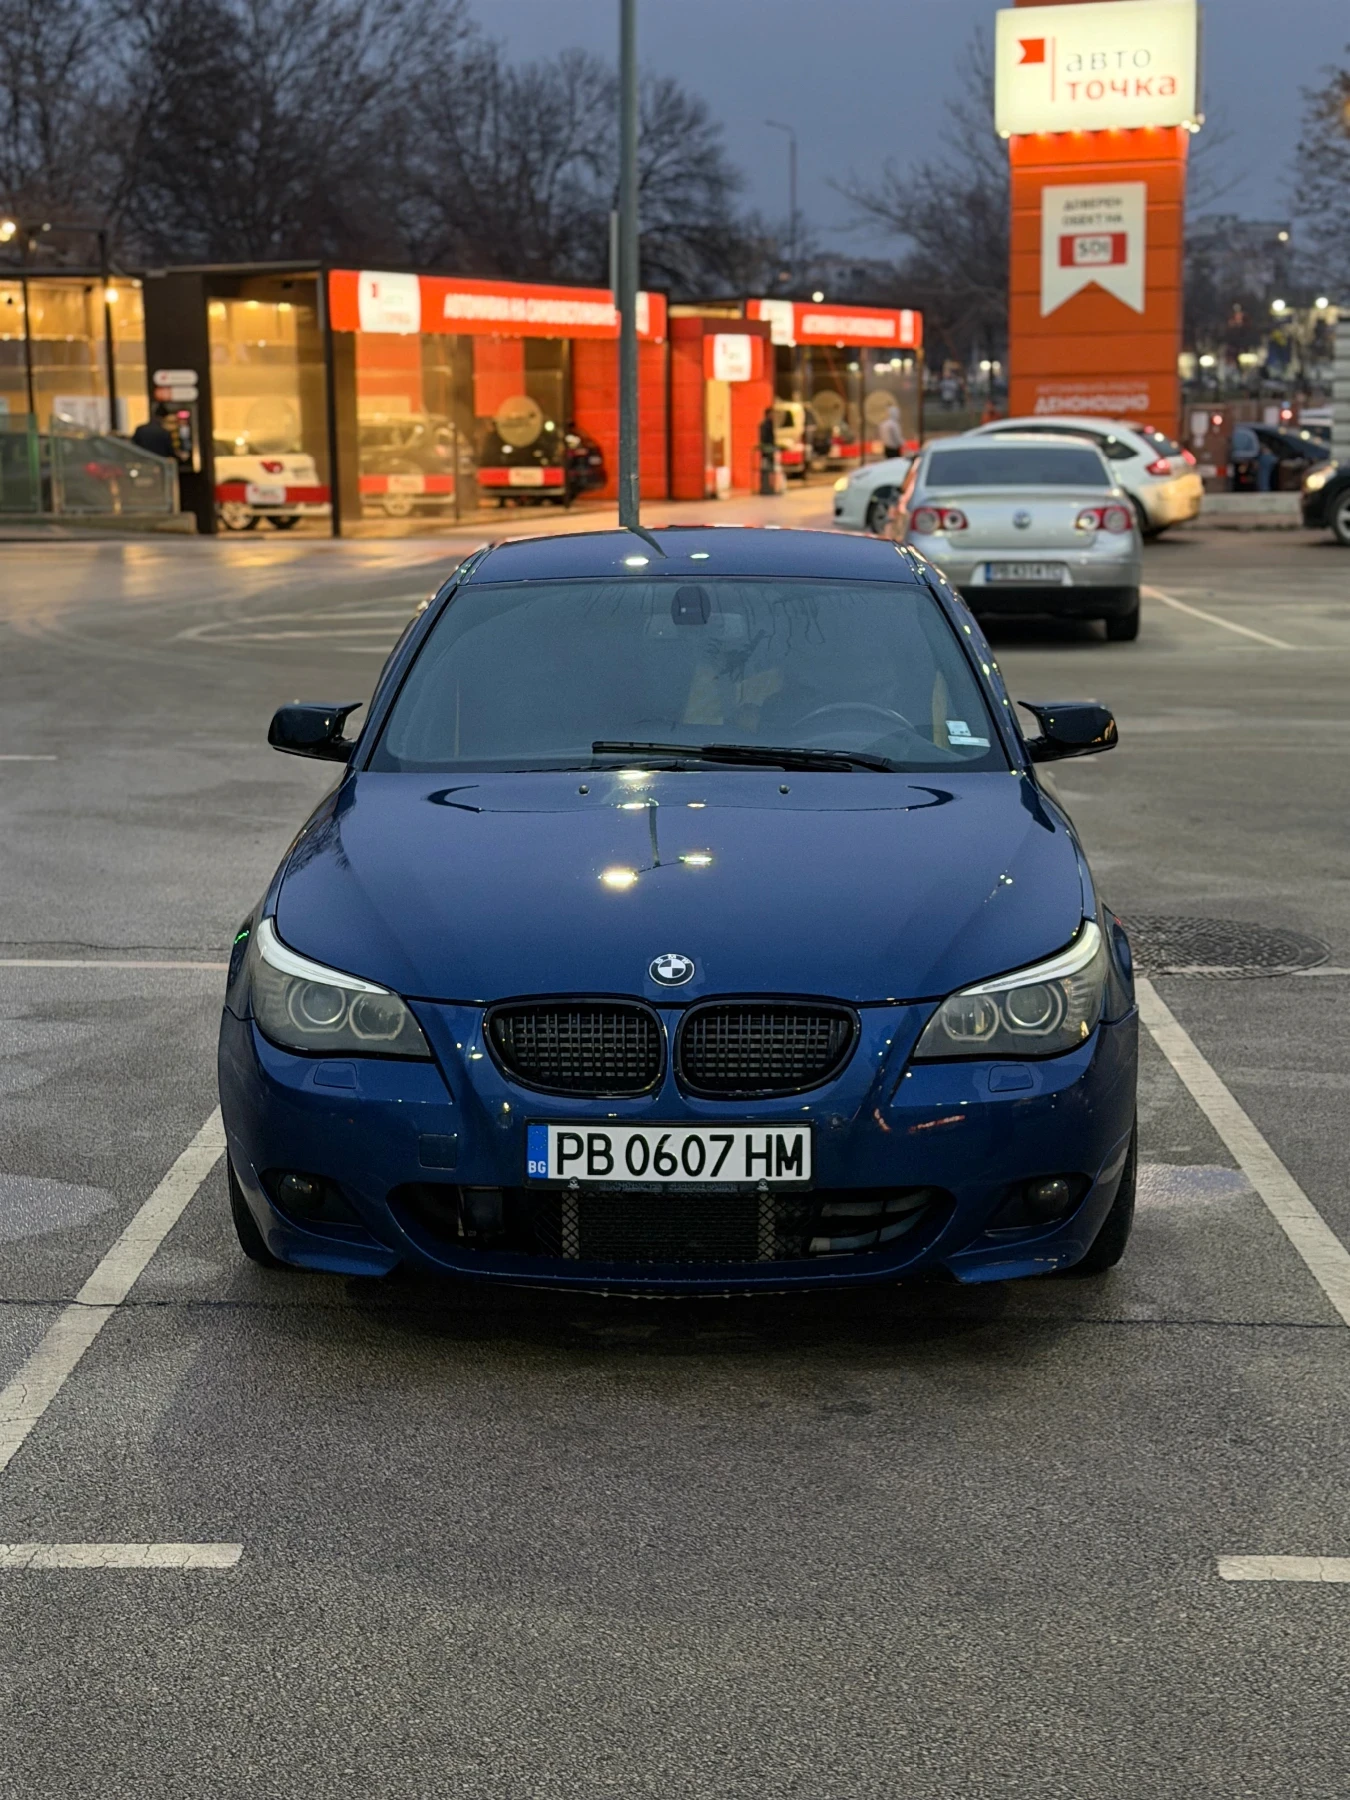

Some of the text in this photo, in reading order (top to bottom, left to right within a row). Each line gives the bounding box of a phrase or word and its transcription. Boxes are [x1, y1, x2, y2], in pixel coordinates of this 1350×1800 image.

[1066, 48, 1151, 72] авто
[1066, 76, 1178, 101] точка
[528, 1160, 546, 1174] BG
[557, 1132, 804, 1178] PB 0607 HM
